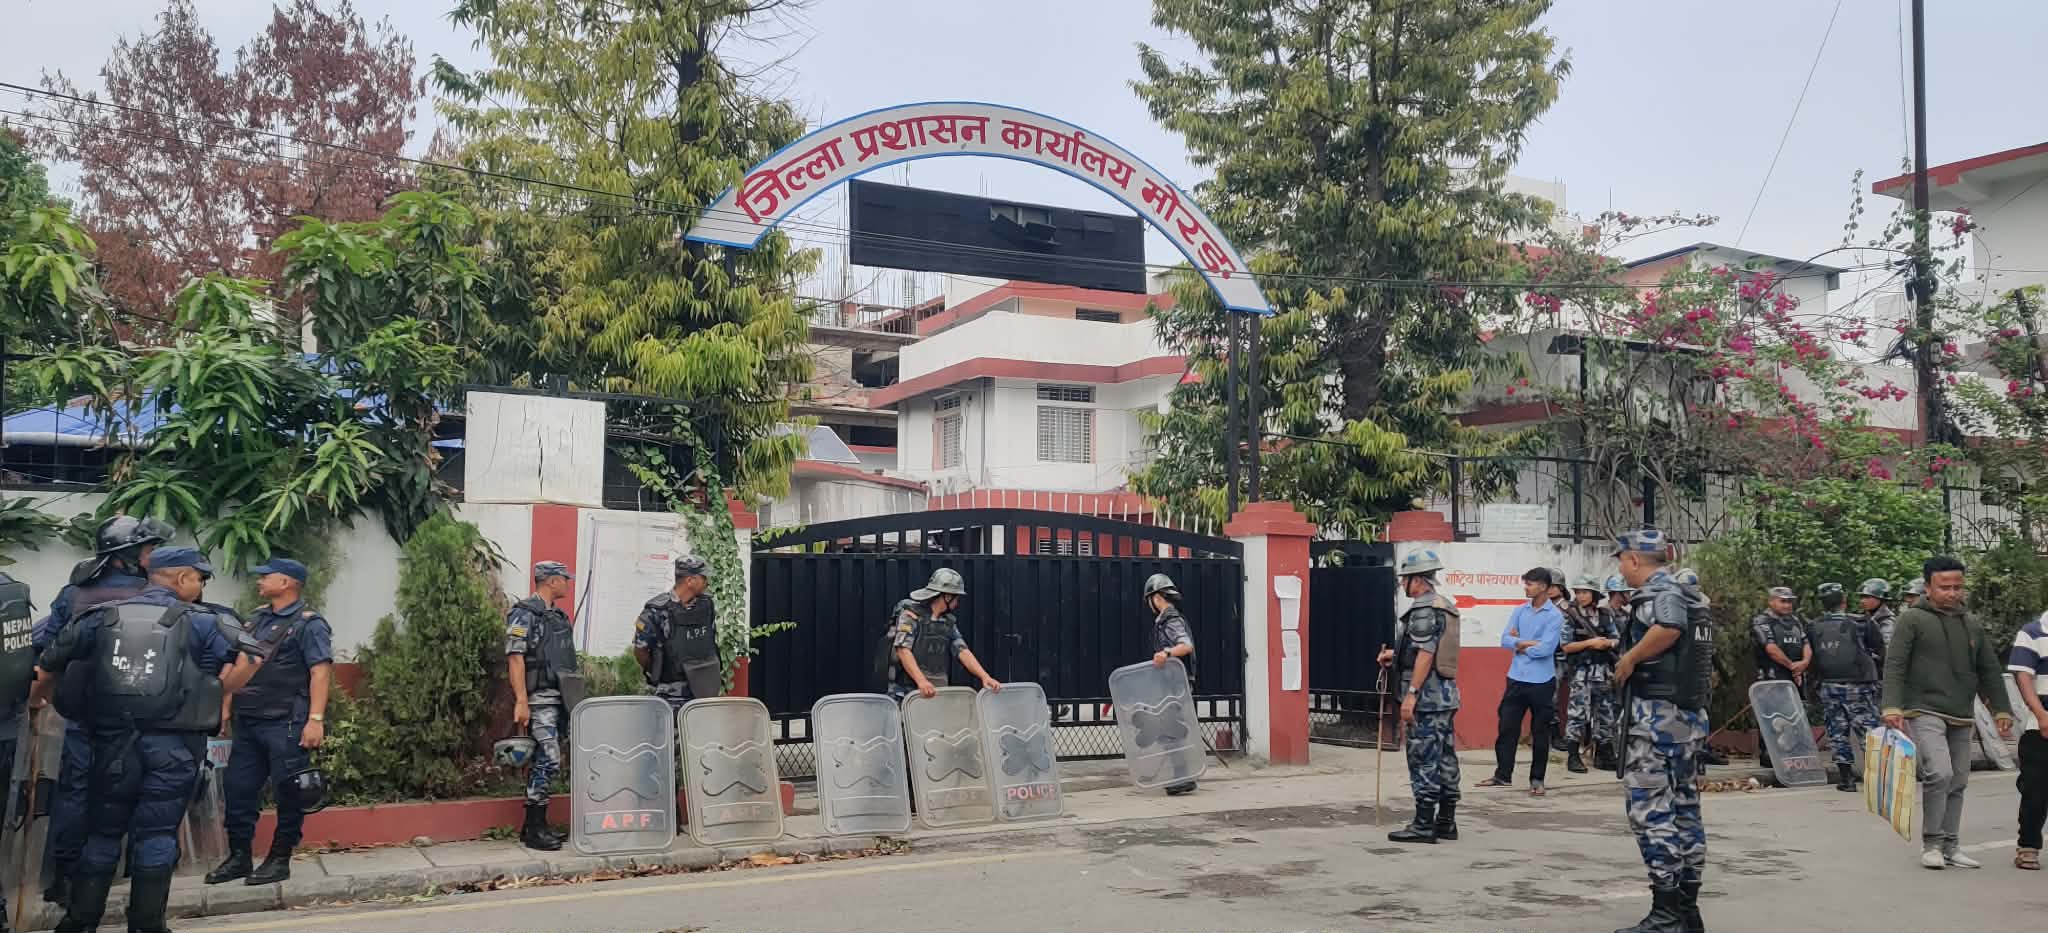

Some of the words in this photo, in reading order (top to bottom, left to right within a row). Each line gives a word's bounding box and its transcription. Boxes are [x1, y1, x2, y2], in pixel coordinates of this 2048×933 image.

[735, 136, 845, 223] जिल्ला
[849, 115, 990, 162] प्रशासन
[1001, 119, 1136, 190] कार्यालय
[4, 633, 33, 651] POLICE
[1006, 784, 1057, 801] POLICE
